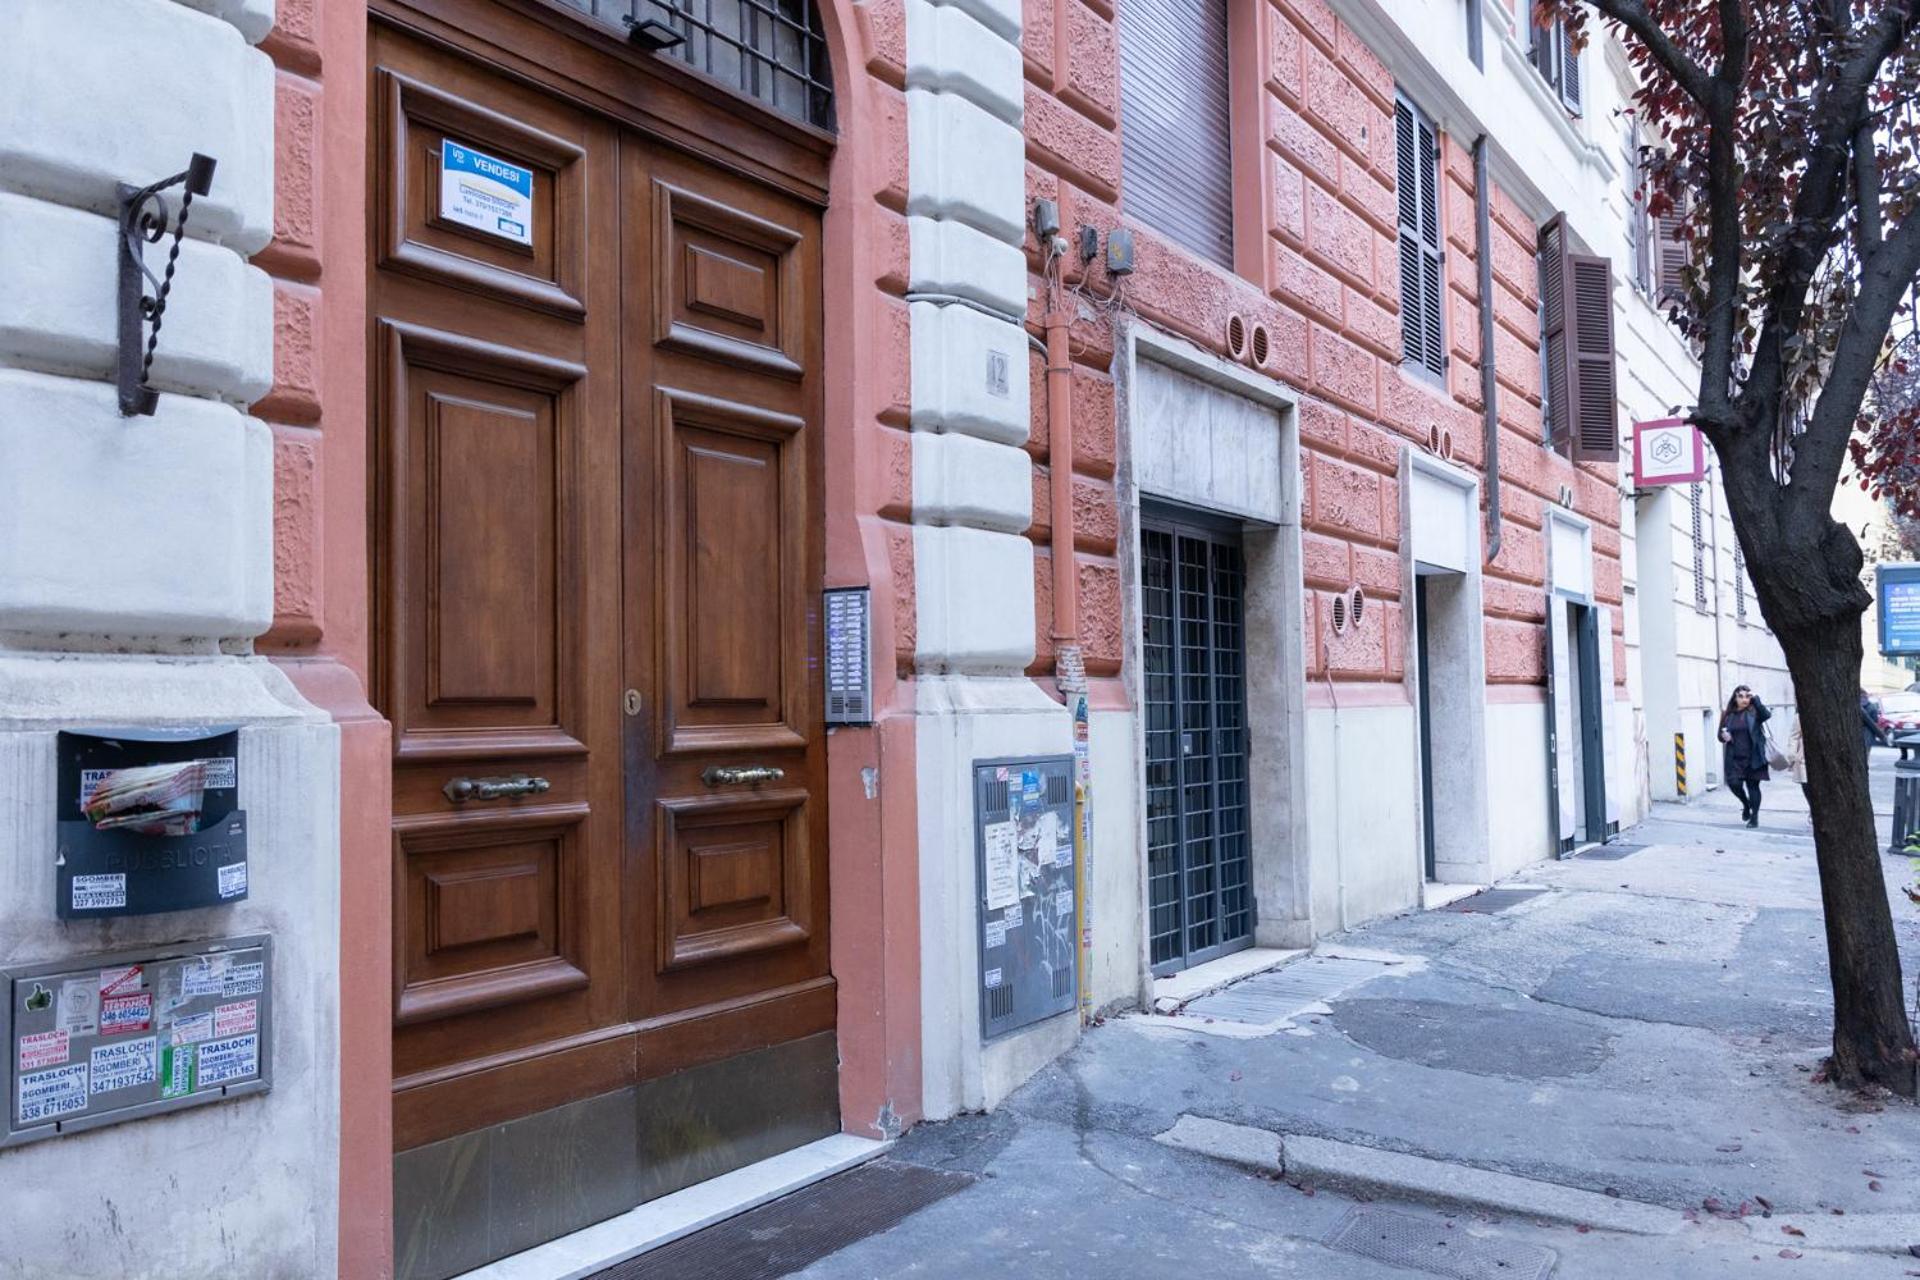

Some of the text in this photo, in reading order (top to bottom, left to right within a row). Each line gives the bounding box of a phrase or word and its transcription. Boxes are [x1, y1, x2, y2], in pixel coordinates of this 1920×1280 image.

[473, 157, 521, 184] VENDESI
[84, 771, 112, 782] TRAS
[22, 1029, 68, 1044] TRASLOCHI
[200, 1037, 255, 1055] TRASLOCHI
[93, 1040, 155, 1060] TRASLOCHI
[22, 1064, 86, 1085] TRASLOCHI
[92, 1057, 141, 1074] SGOMBERI
[22, 1082, 70, 1099] SGOMBERI
[92, 1071, 154, 1093] 3471937542
[22, 1106, 41, 1120] 338
[43, 1096, 86, 1115] 6715053
